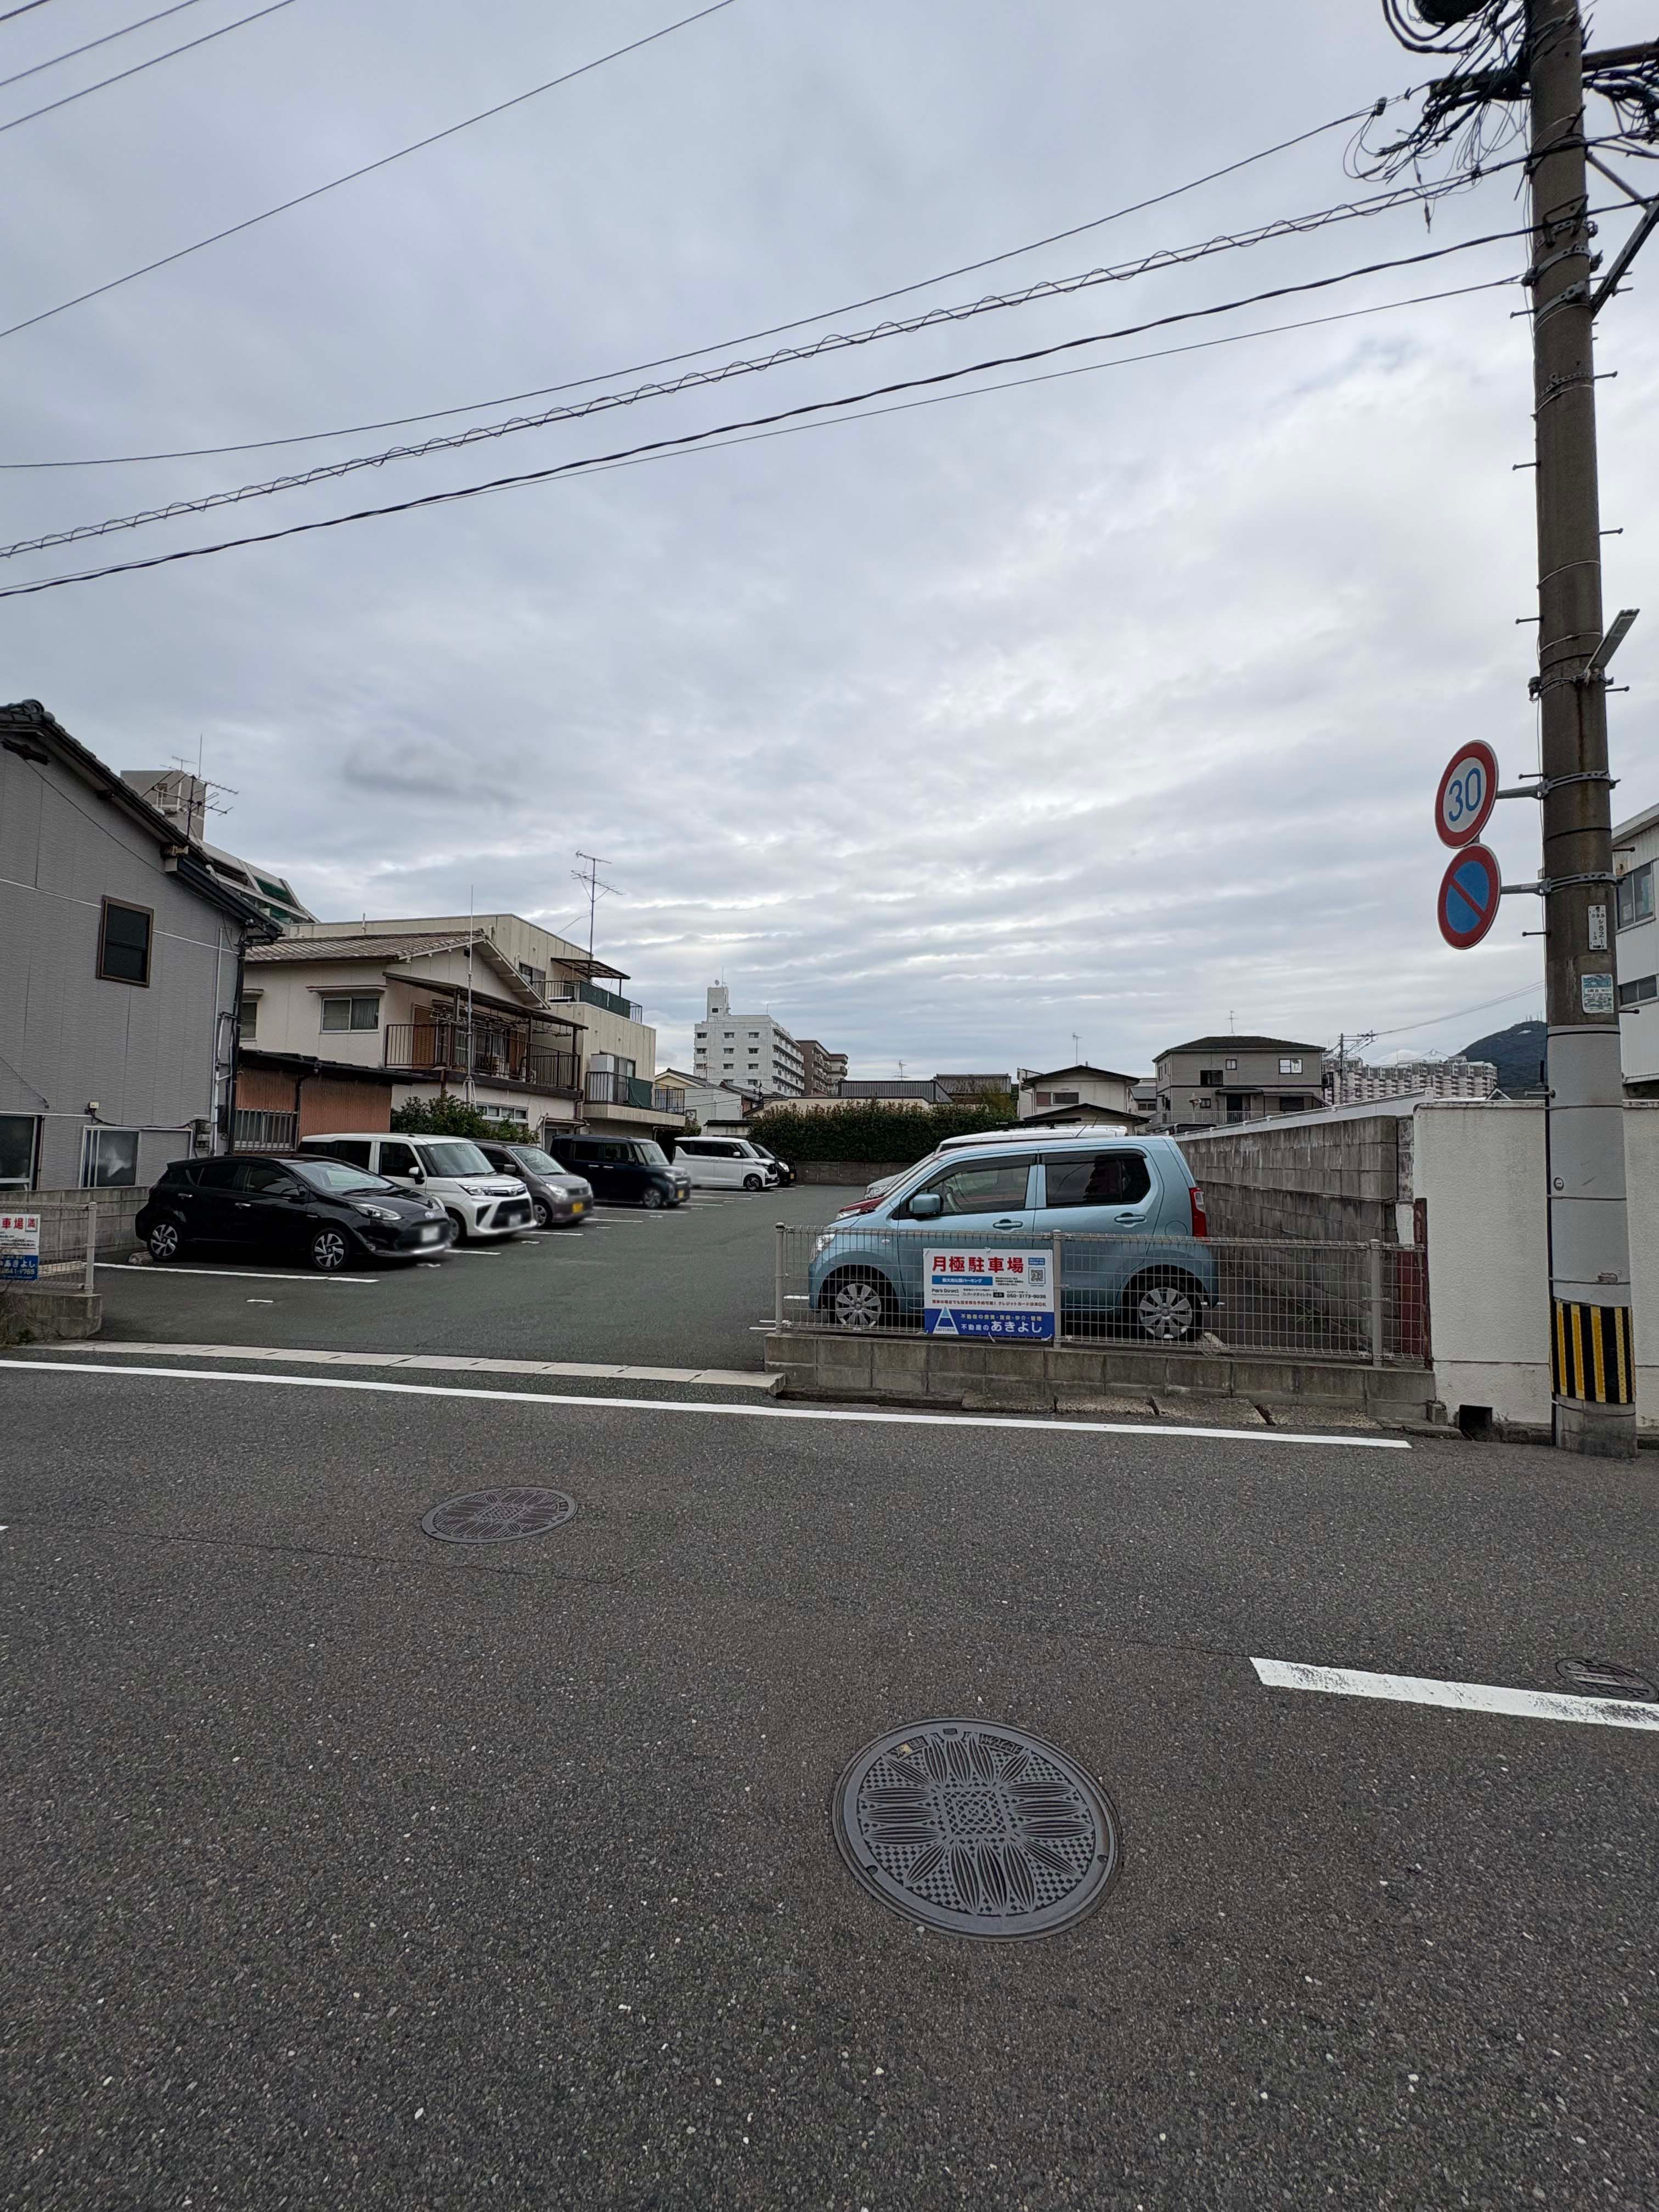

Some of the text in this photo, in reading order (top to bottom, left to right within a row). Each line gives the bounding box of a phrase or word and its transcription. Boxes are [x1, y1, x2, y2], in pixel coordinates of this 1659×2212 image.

[1448, 767, 1481, 822] 30
[2, 1217, 23, 1229] 車場
[932, 1256, 1024, 1273] 月極駐車場
[961, 1321, 1042, 1334] 不動産のあきよし
